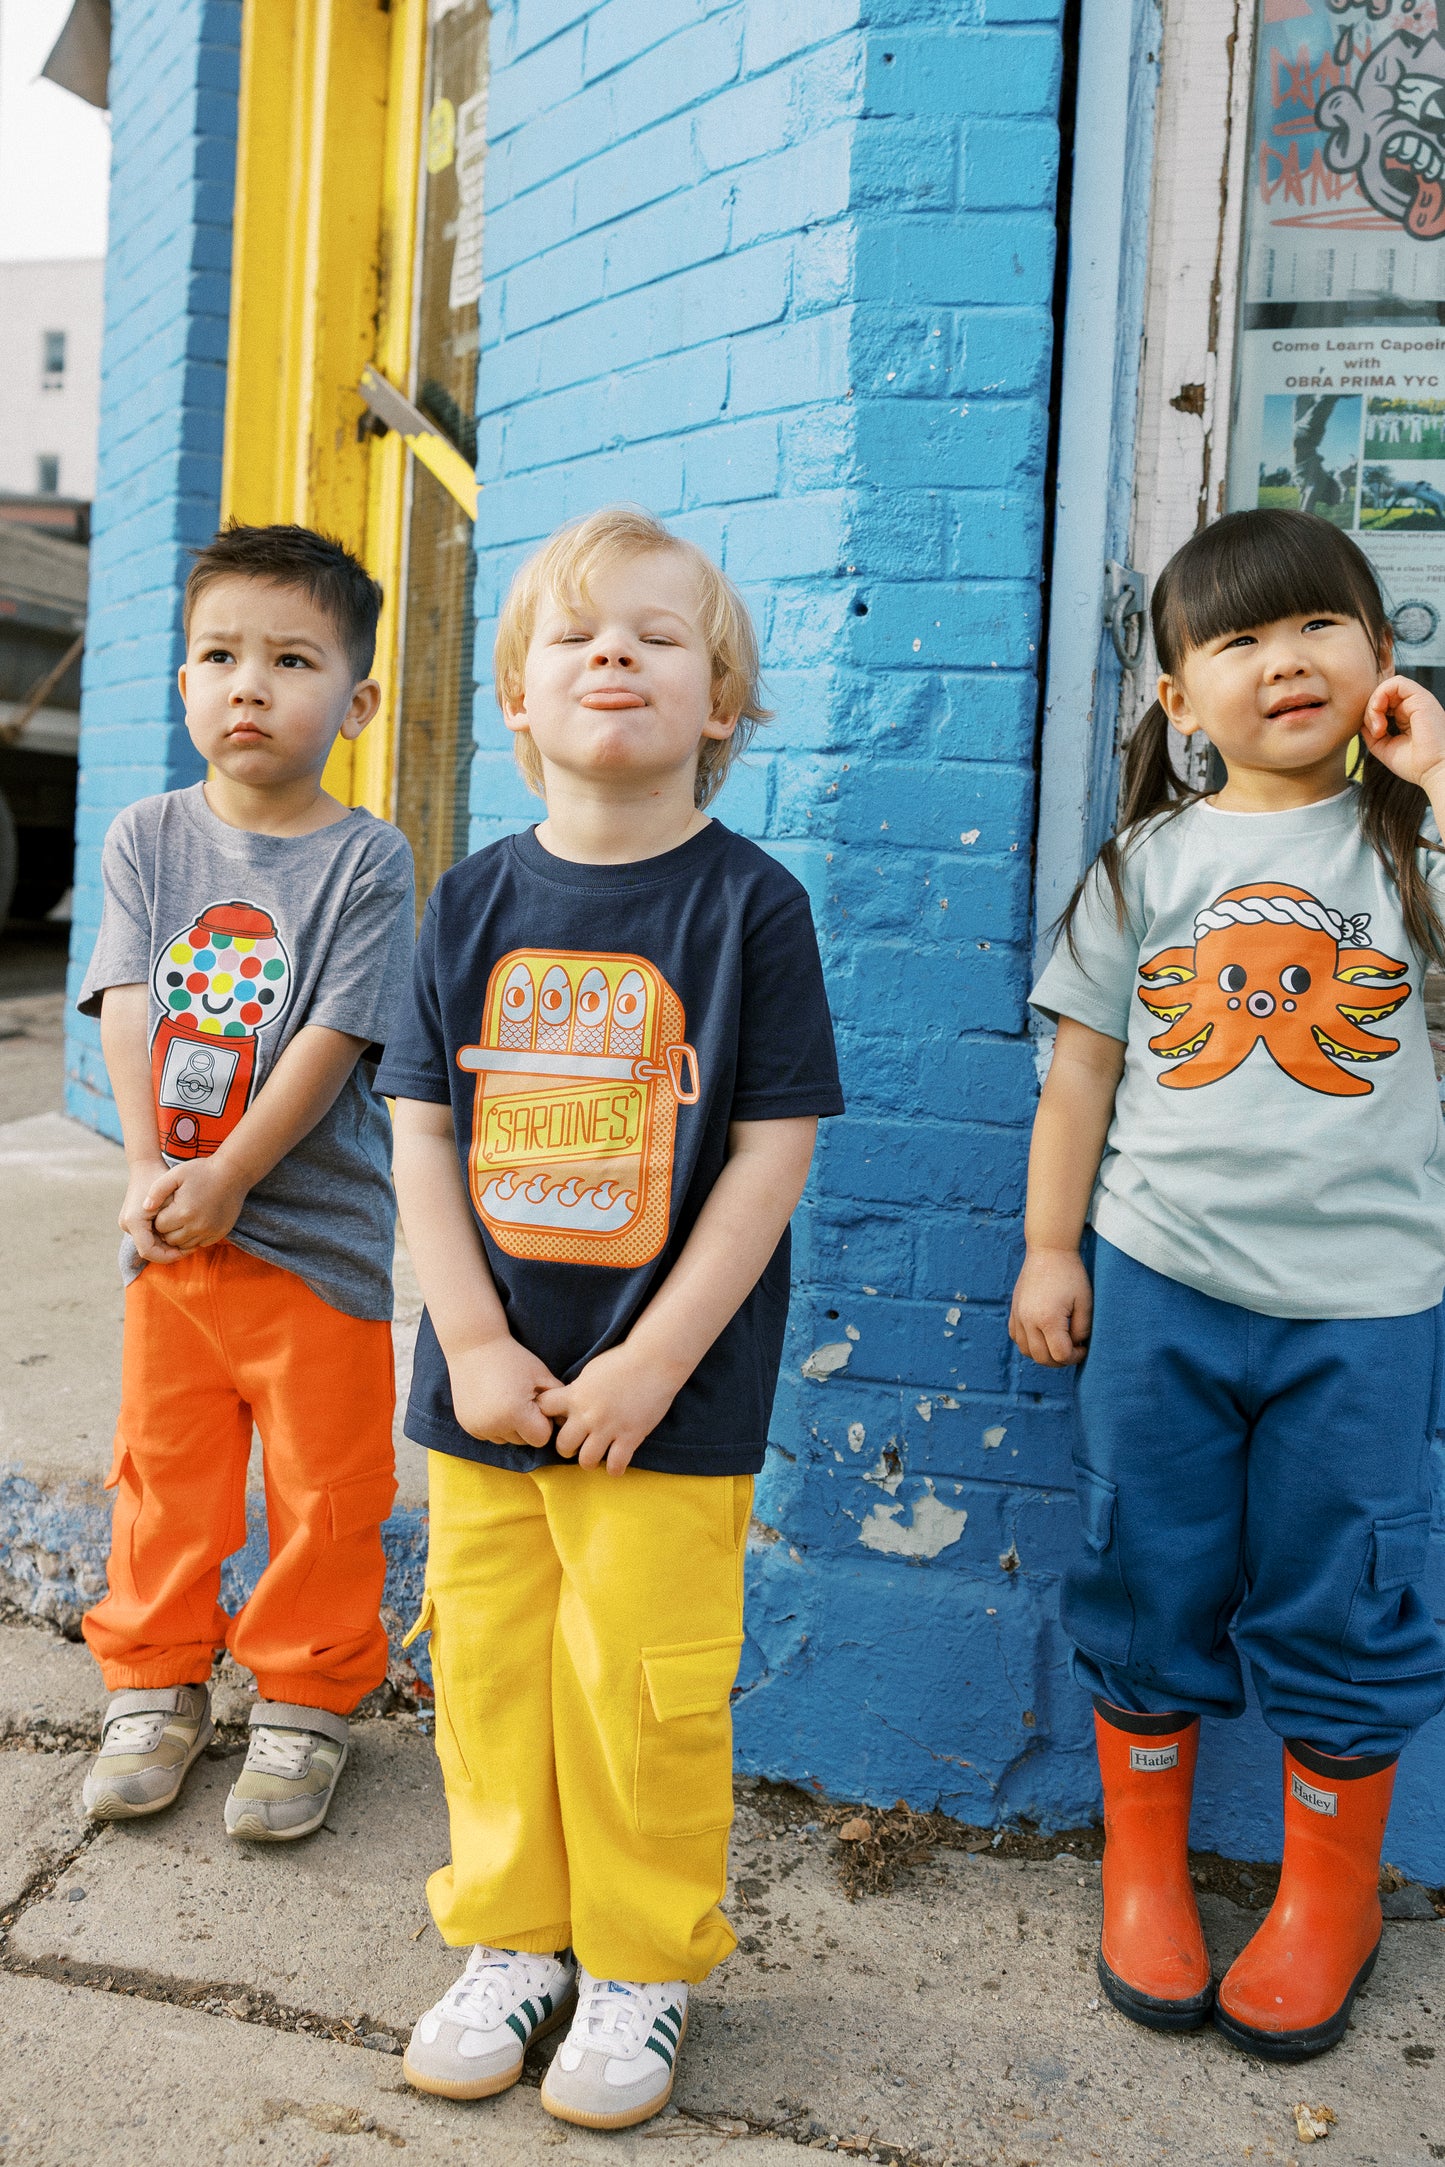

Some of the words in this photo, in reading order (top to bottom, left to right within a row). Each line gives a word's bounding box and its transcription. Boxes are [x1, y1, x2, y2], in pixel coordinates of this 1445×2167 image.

[1272, 340, 1320, 352] Come
[1326, 339, 1375, 352] Learn
[1344, 357, 1381, 369] with
[1285, 376, 1334, 388] OBRA
[1340, 375, 1397, 388] PRIMA
[1403, 375, 1439, 387] YYC
[494, 1095, 630, 1154] SARDINES
[1135, 1753, 1175, 1766] Hatley
[1294, 1780, 1331, 1811] Hatley
